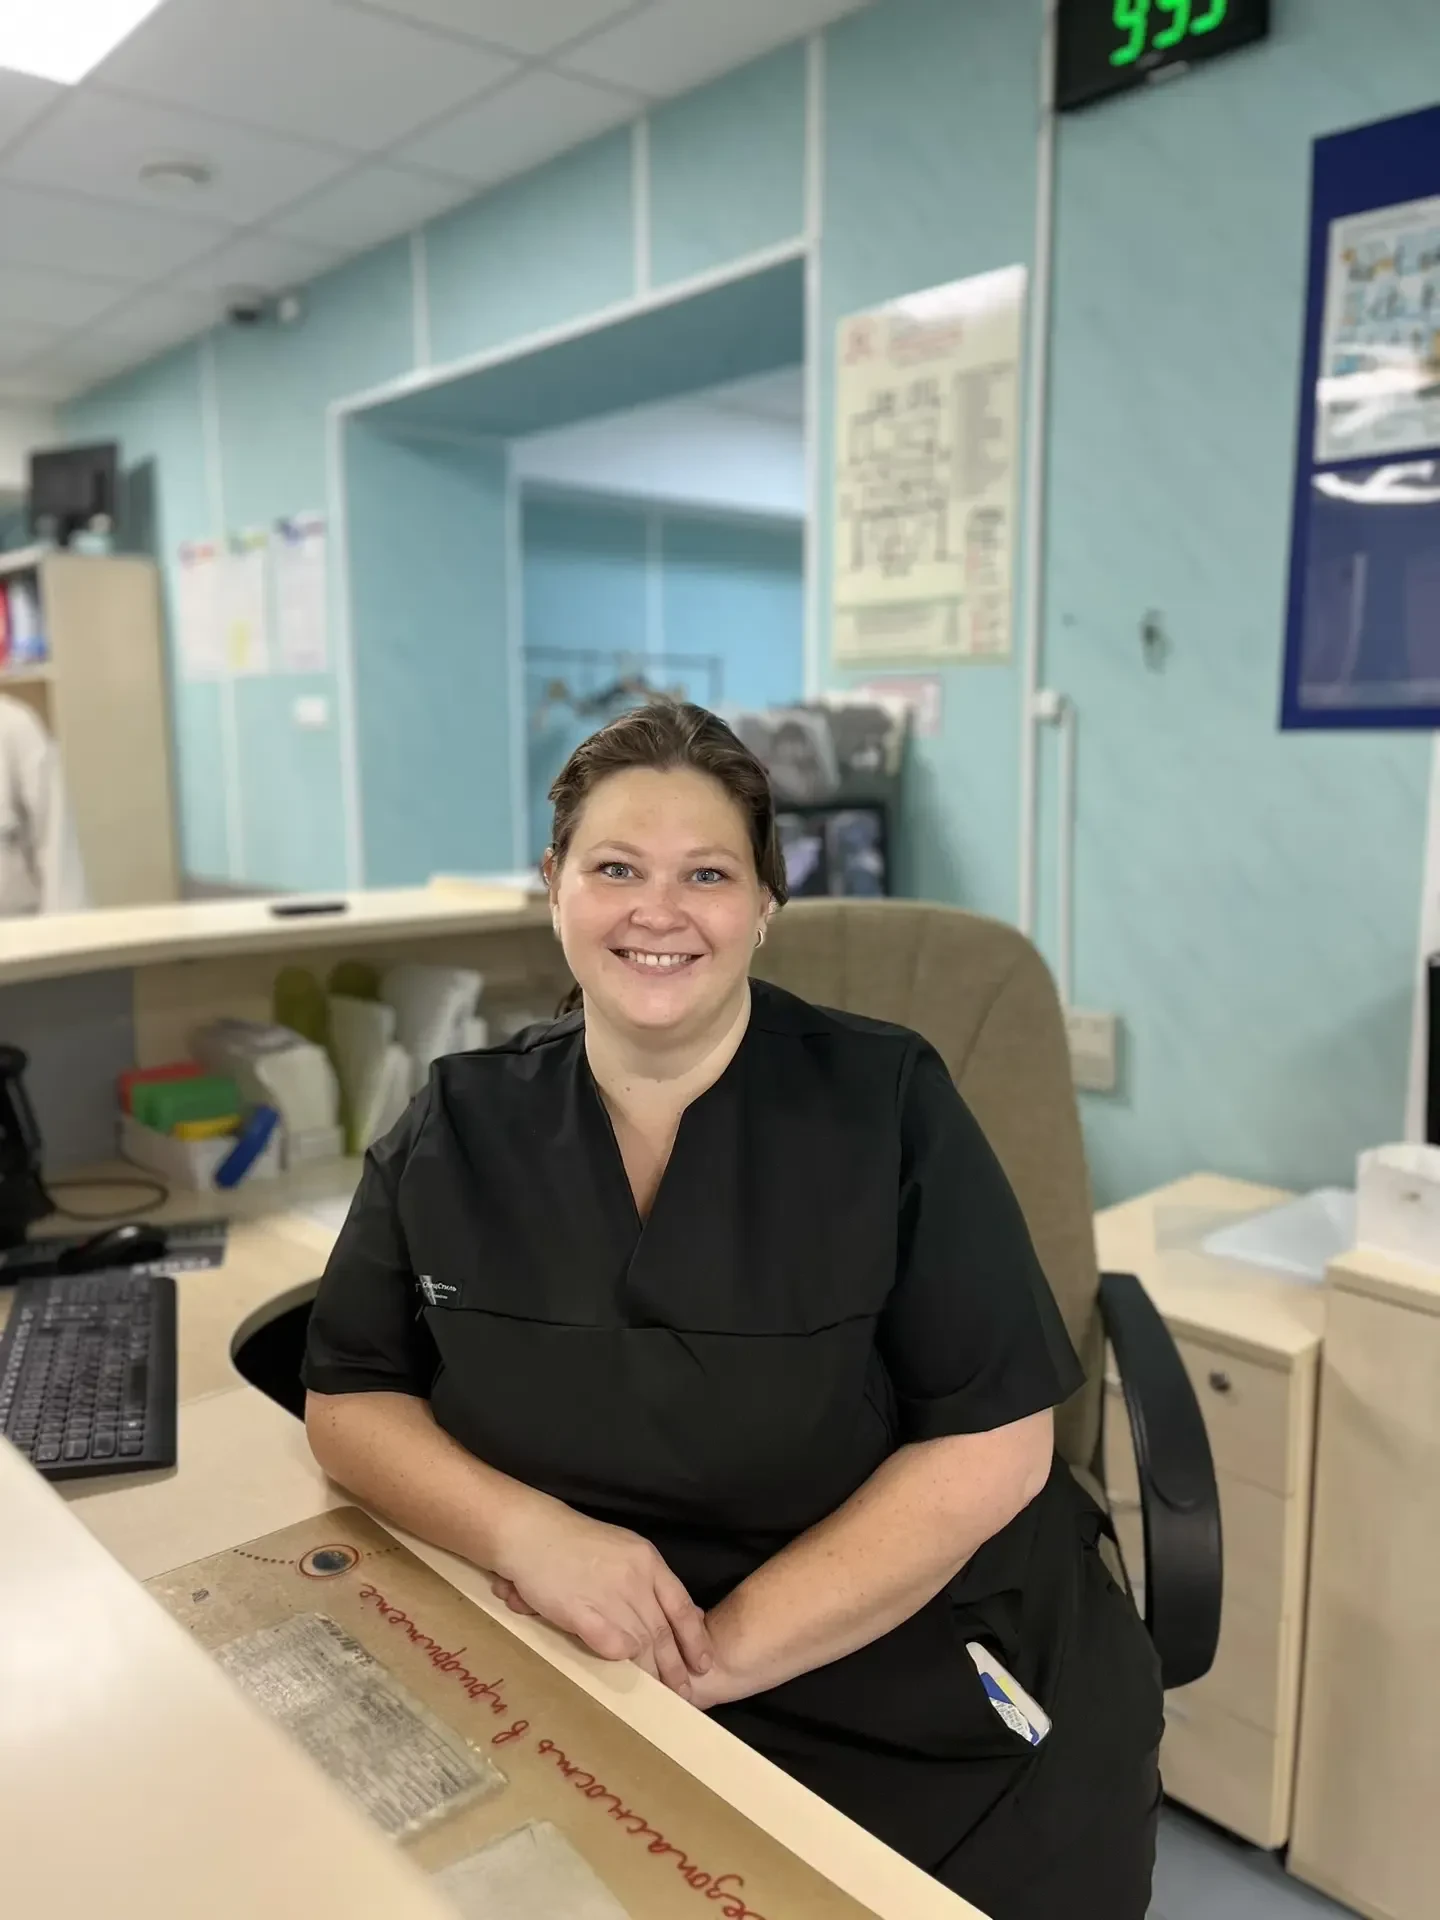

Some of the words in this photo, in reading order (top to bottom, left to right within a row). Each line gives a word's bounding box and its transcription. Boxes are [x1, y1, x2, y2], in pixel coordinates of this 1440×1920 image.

[358, 1583, 508, 1715] приоритете
[491, 1719, 530, 1746] в
[537, 1738, 768, 1920] езопасность
